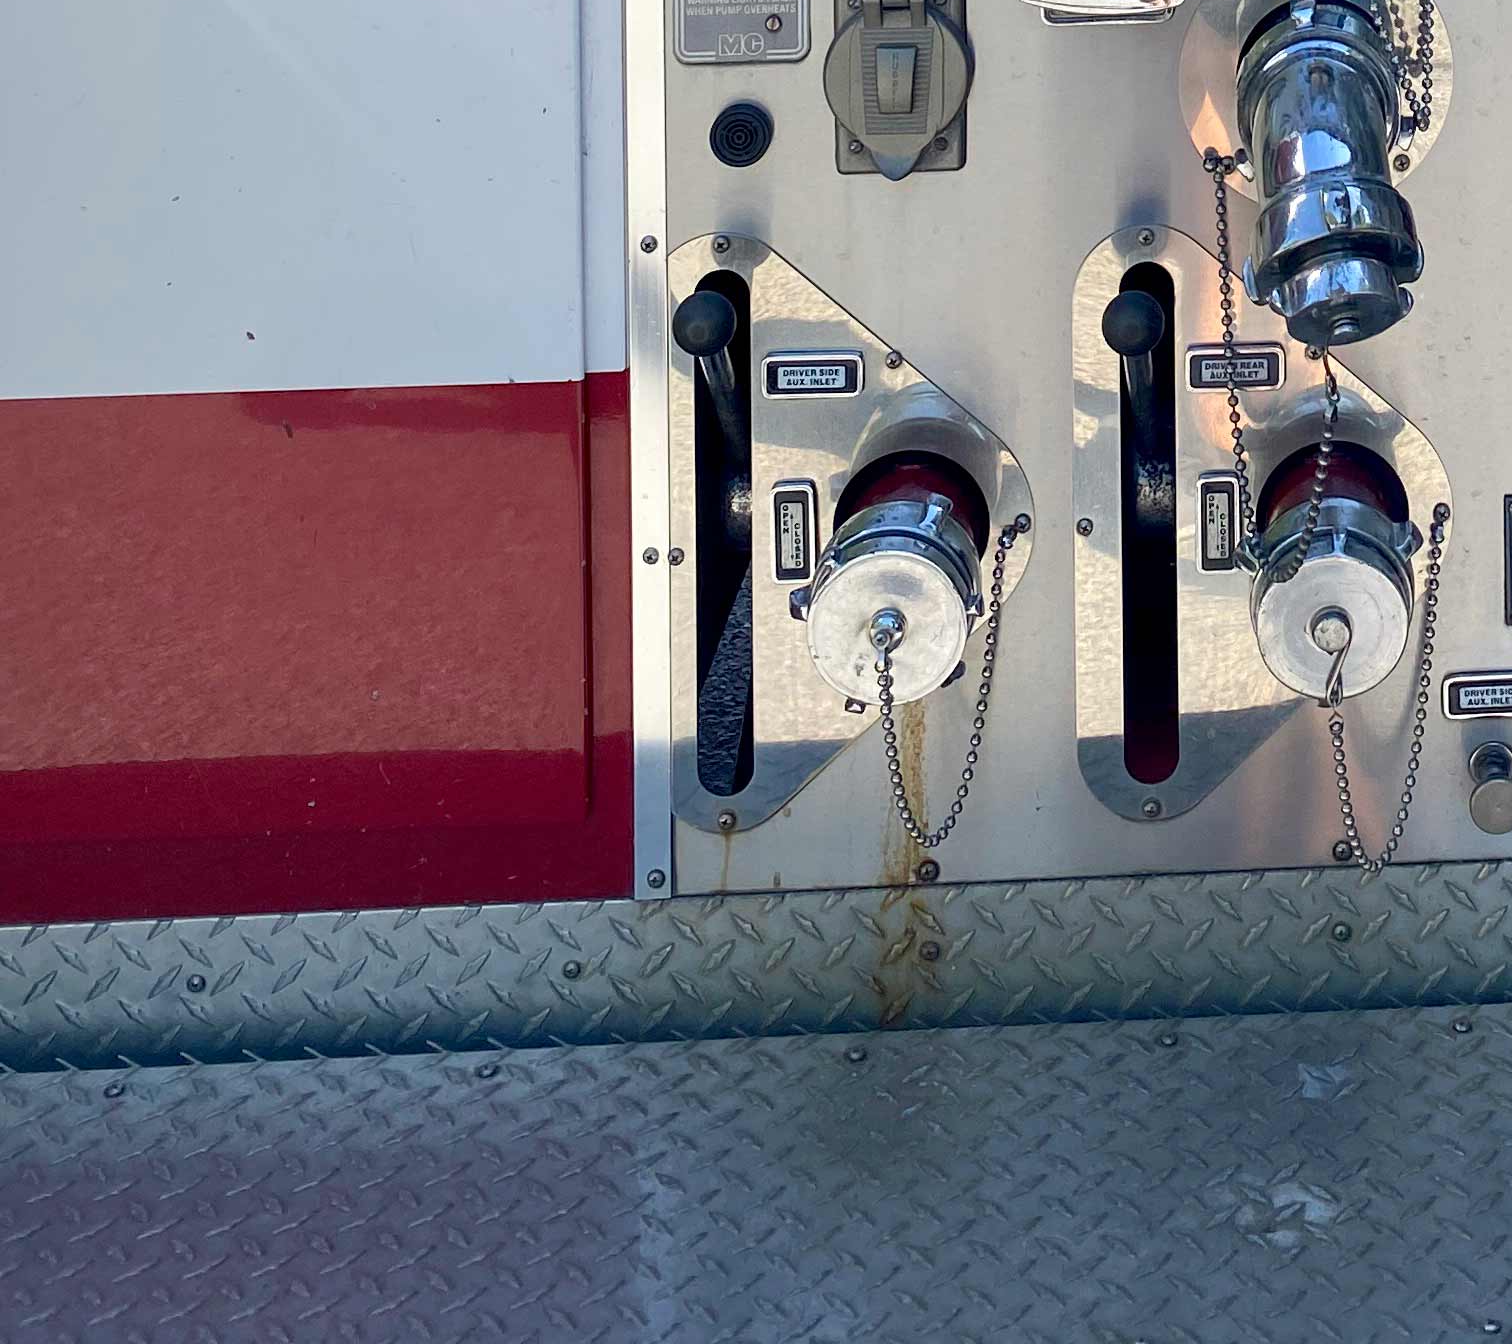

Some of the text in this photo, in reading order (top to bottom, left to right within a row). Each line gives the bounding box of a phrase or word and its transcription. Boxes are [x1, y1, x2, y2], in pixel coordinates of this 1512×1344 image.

[686, 4, 796, 16] WHEN PUMP OVERHEATS
[783, 369, 816, 377] DRIVER
[810, 378, 836, 386] INLET
[1464, 689, 1496, 697] DRIVER
